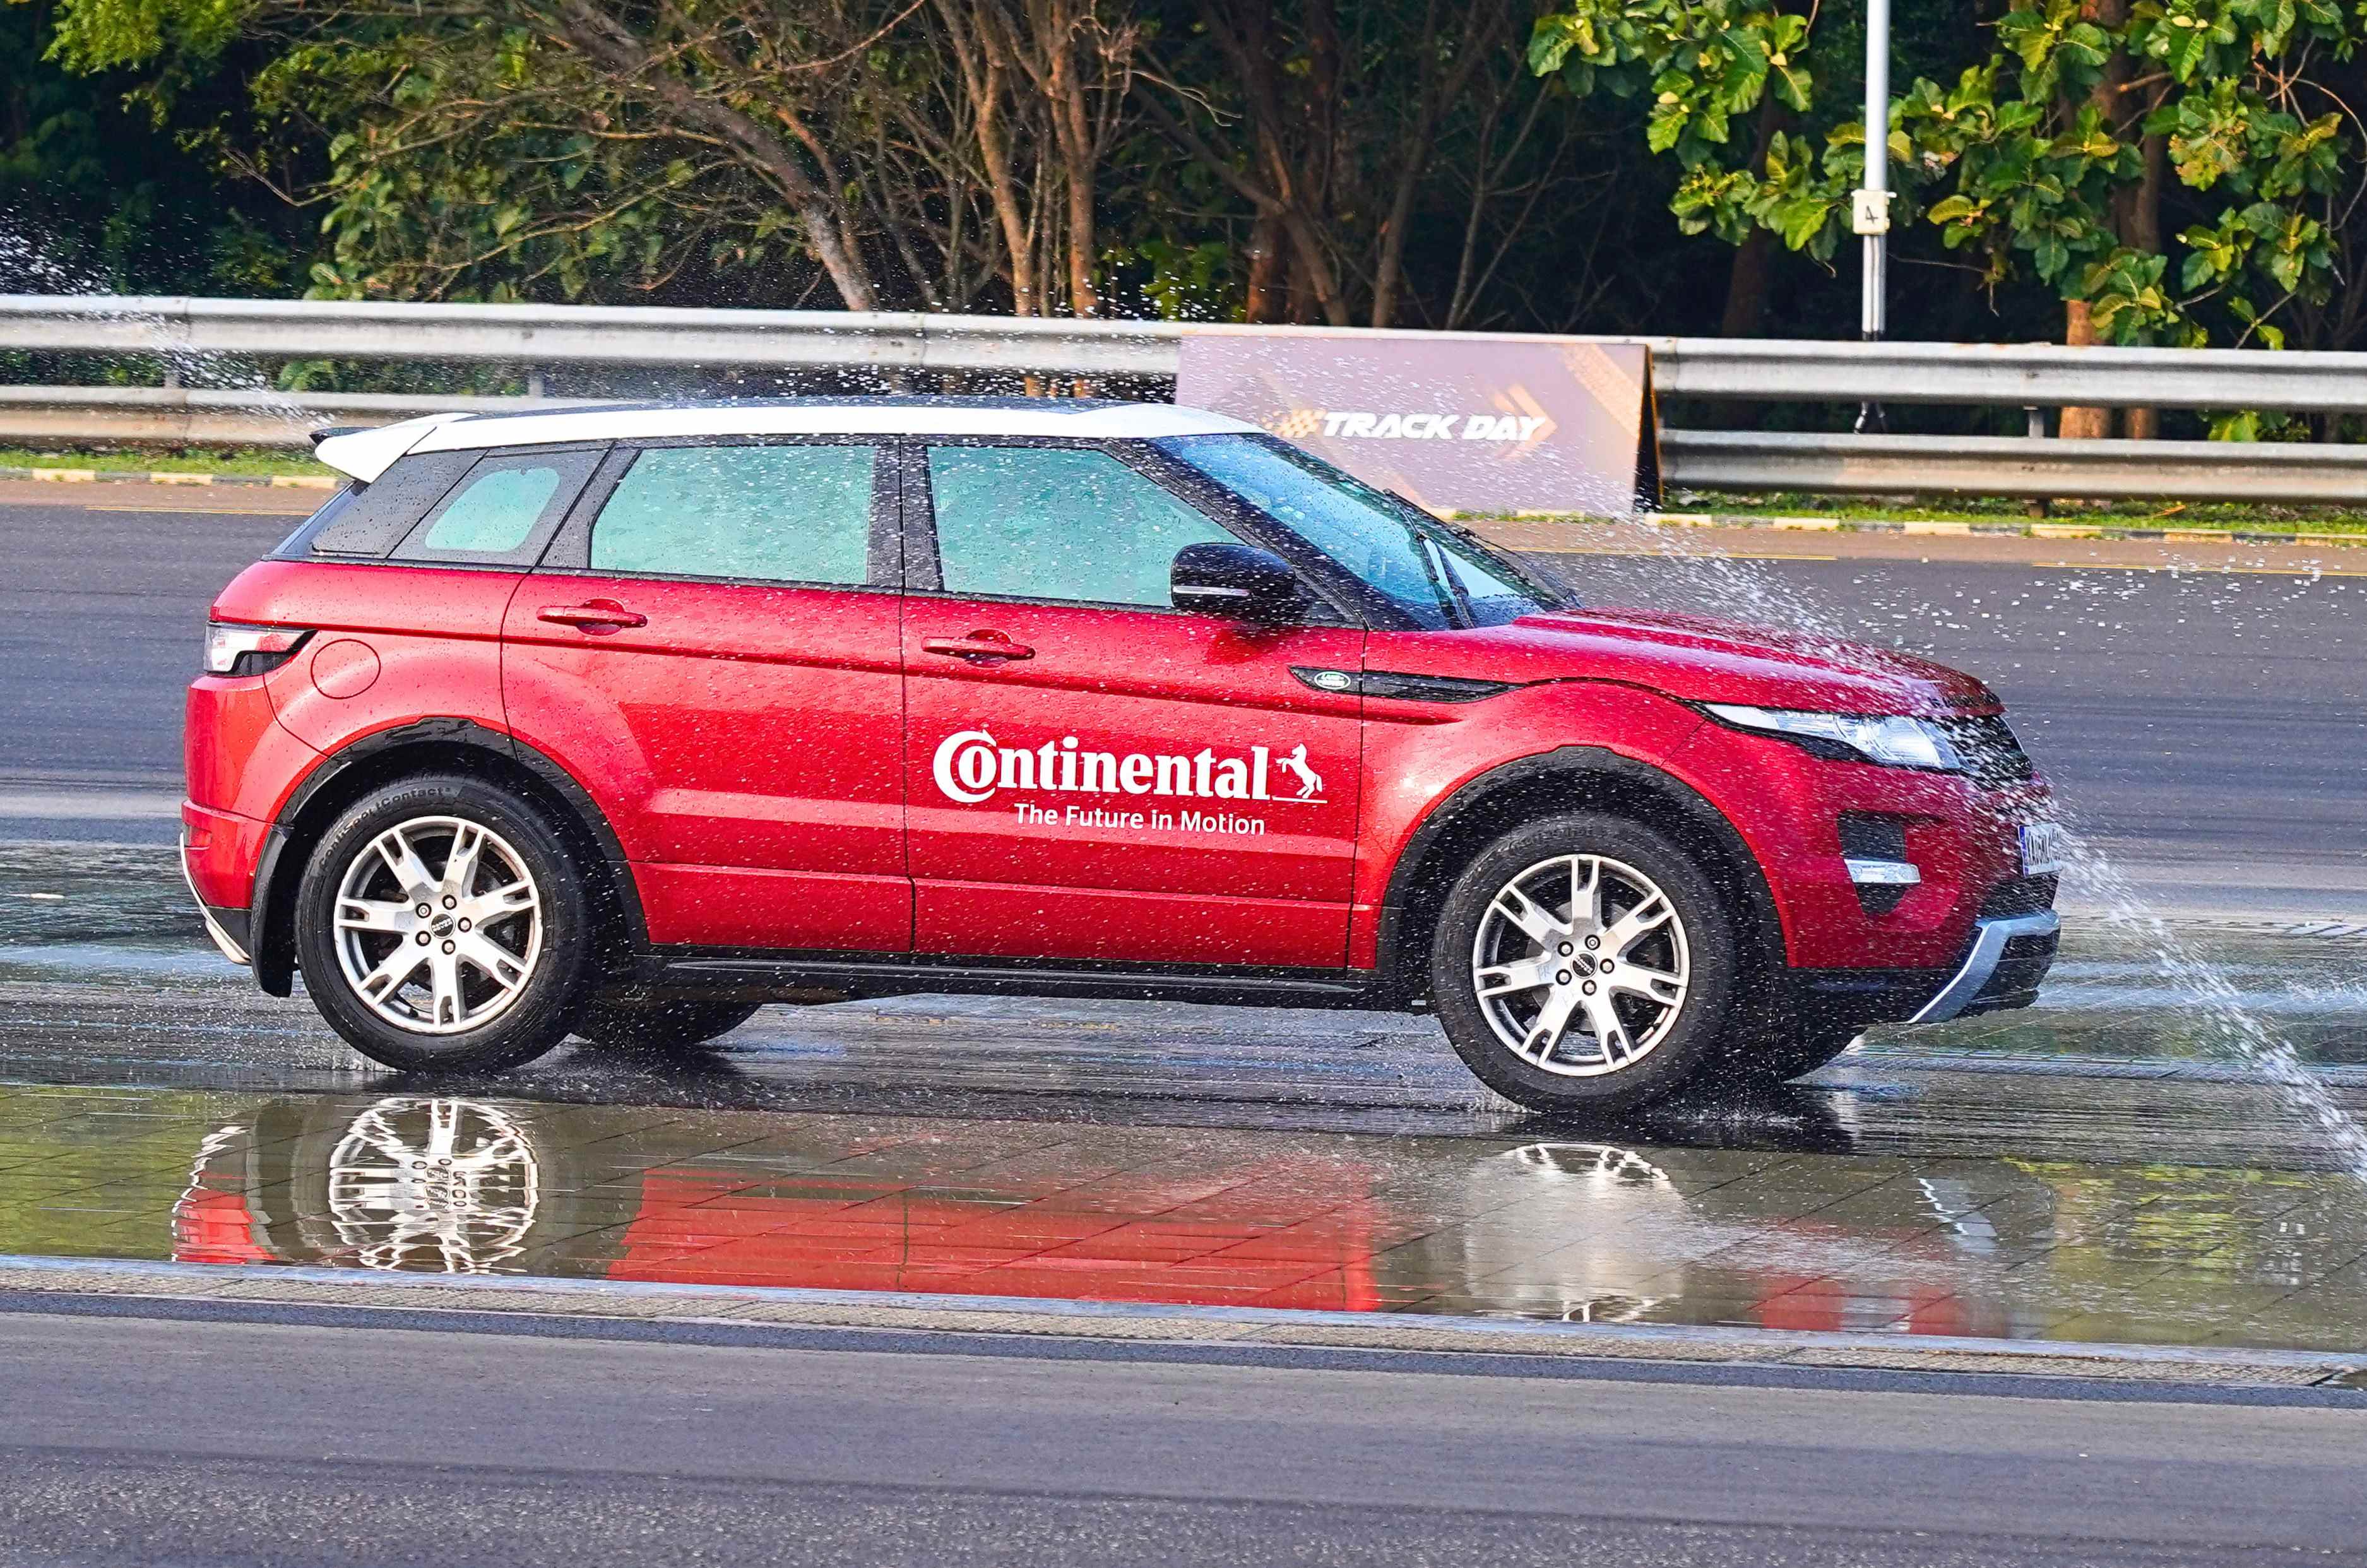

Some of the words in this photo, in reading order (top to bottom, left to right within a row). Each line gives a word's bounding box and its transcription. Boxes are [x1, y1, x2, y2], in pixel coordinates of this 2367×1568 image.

[1865, 205, 1878, 223] 4
[1324, 412, 1460, 439] TRACK
[1462, 415, 1546, 441] DAY
[933, 729, 1270, 803] Continental
[1014, 803, 1058, 825] The
[1065, 805, 1144, 829] Future
[1151, 809, 1172, 830] in
[1180, 811, 1264, 835] Motion
